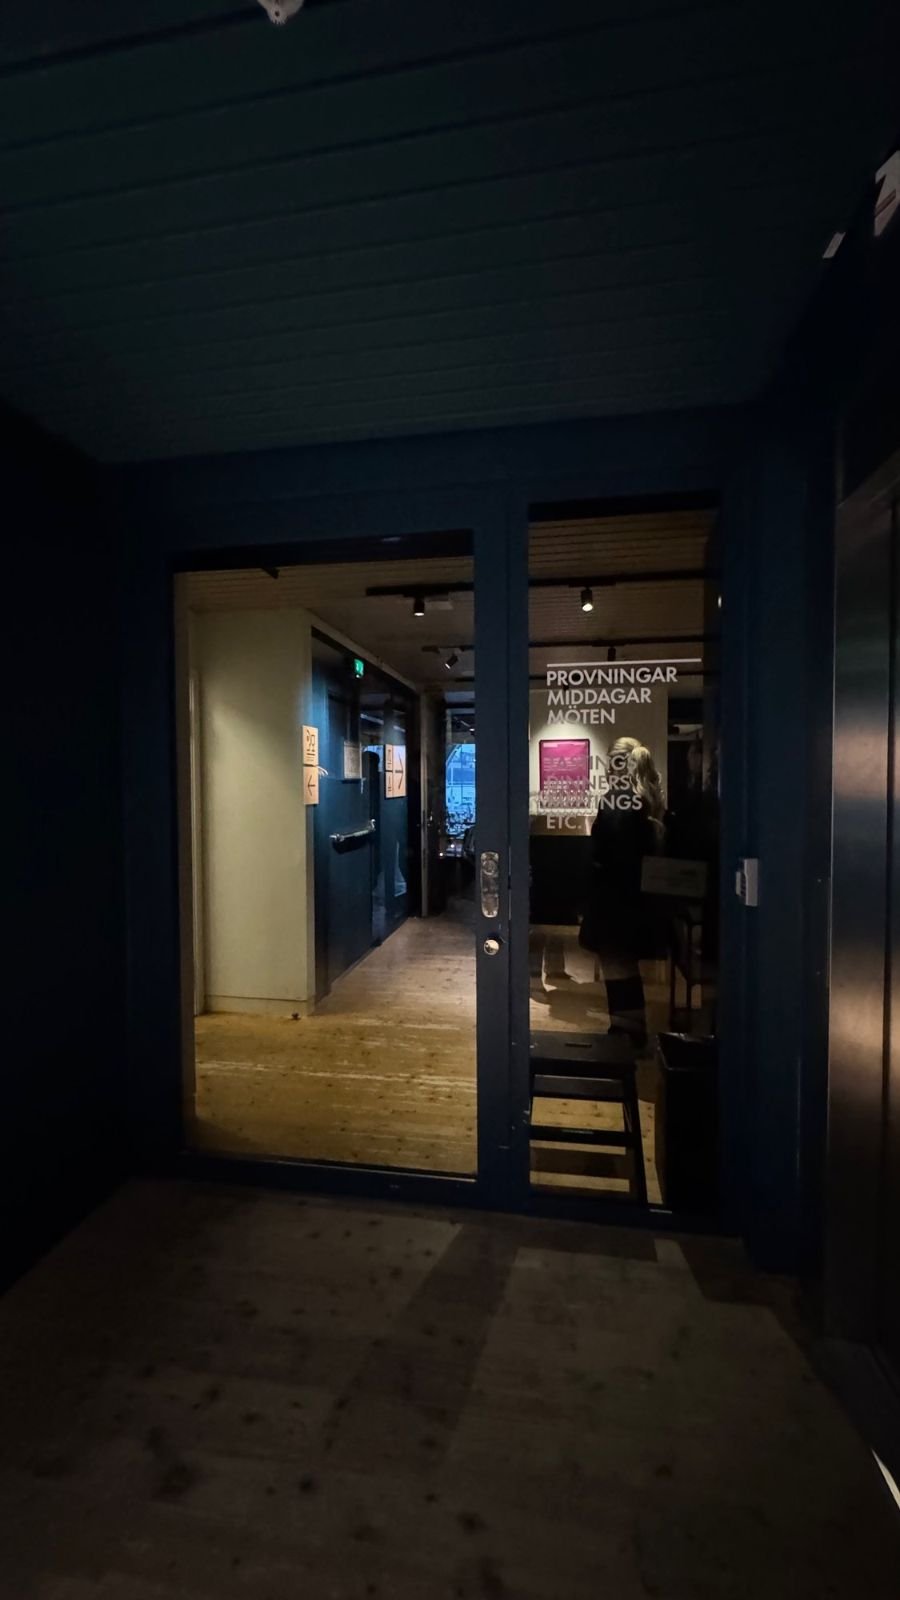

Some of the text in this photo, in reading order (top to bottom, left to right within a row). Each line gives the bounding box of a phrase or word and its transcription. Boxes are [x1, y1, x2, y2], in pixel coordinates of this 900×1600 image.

[546, 666, 678, 686] PROVNINGAR
[547, 687, 651, 706] MIDDAGAR
[547, 705, 616, 724] MÖTEN
[546, 755, 637, 772] ASINGS
[546, 815, 582, 829] ETC.
